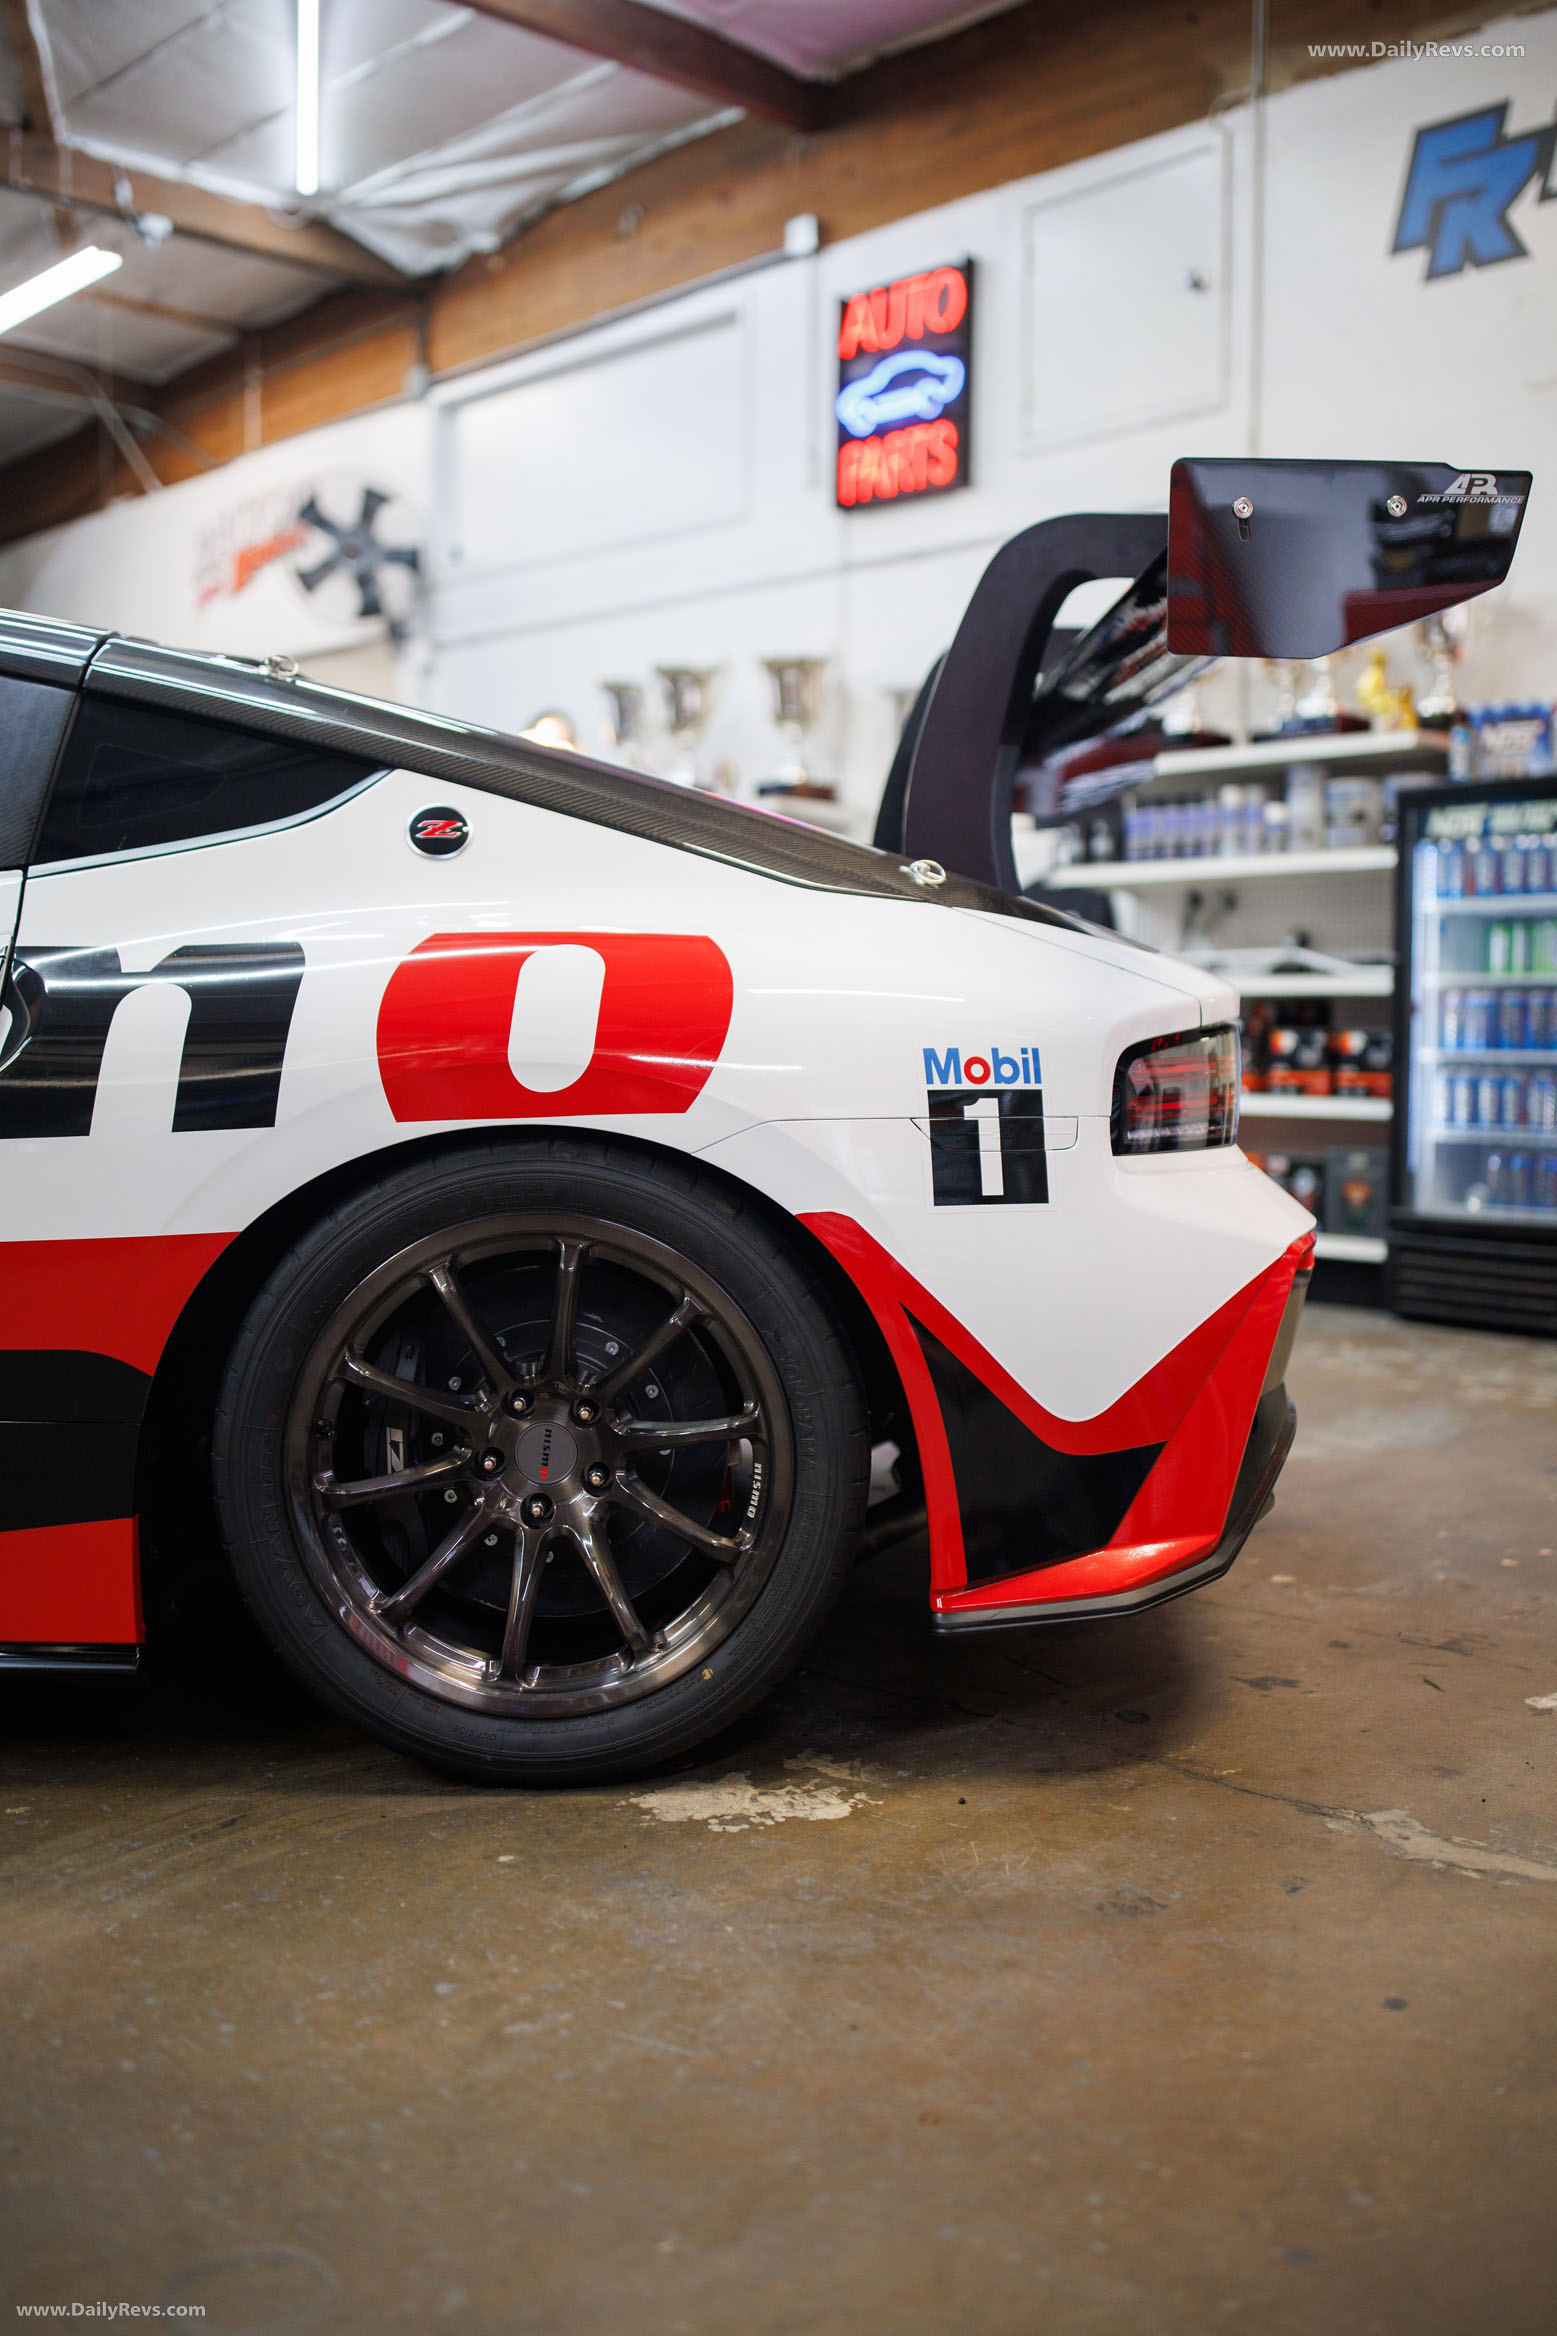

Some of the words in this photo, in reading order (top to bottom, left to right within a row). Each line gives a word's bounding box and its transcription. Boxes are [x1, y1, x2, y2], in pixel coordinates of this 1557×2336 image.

[837, 266, 967, 360] AUTO
[836, 418, 959, 506] PARTS
[1416, 495, 1440, 503] APR
[1441, 495, 1524, 504] PERFORMANCE
[415, 820, 464, 838] Z
[922, 1047, 1043, 1085] Mobil
[963, 1097, 1005, 1197] 1
[540, 1428, 553, 1479] nismo
[747, 1462, 762, 1519] nismo
